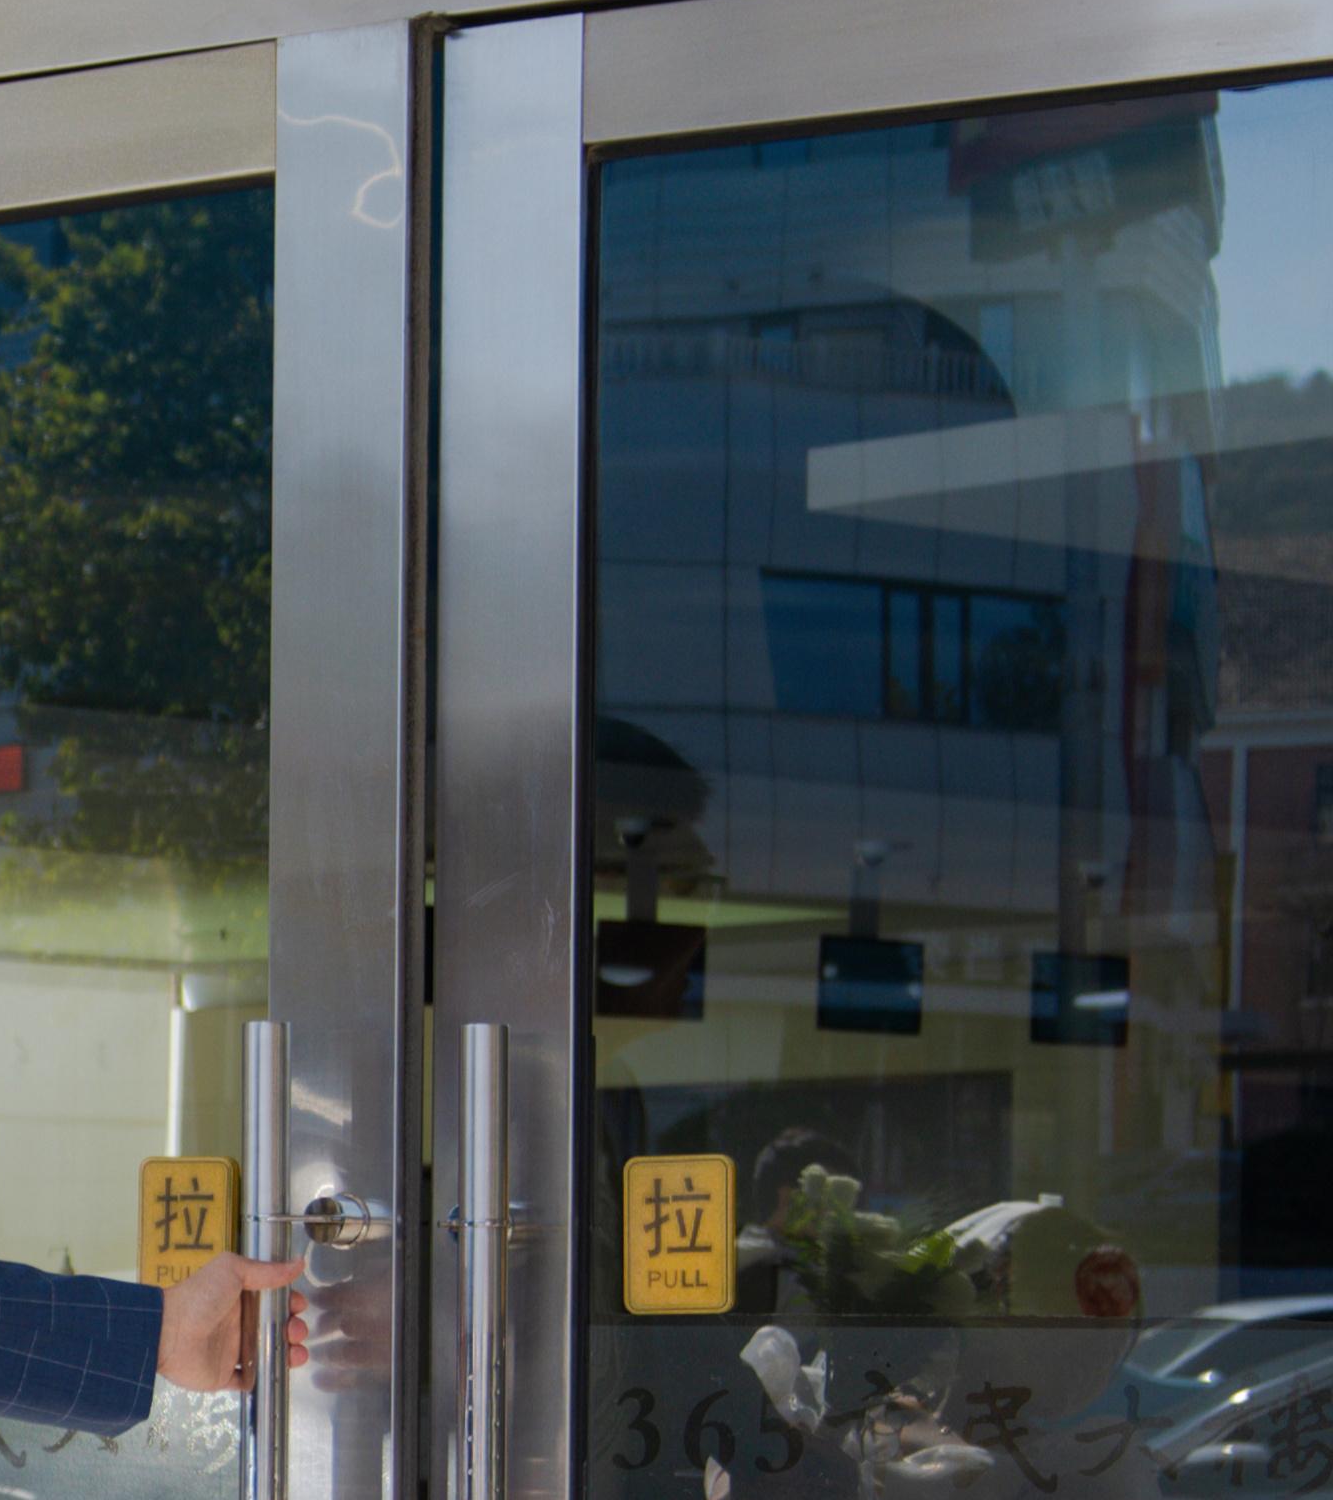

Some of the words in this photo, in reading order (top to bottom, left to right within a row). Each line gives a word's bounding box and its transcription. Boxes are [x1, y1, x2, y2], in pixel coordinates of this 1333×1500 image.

[153, 1176, 216, 1254] 拉
[644, 1177, 713, 1259] 拉
[647, 1268, 709, 1289] PULL
